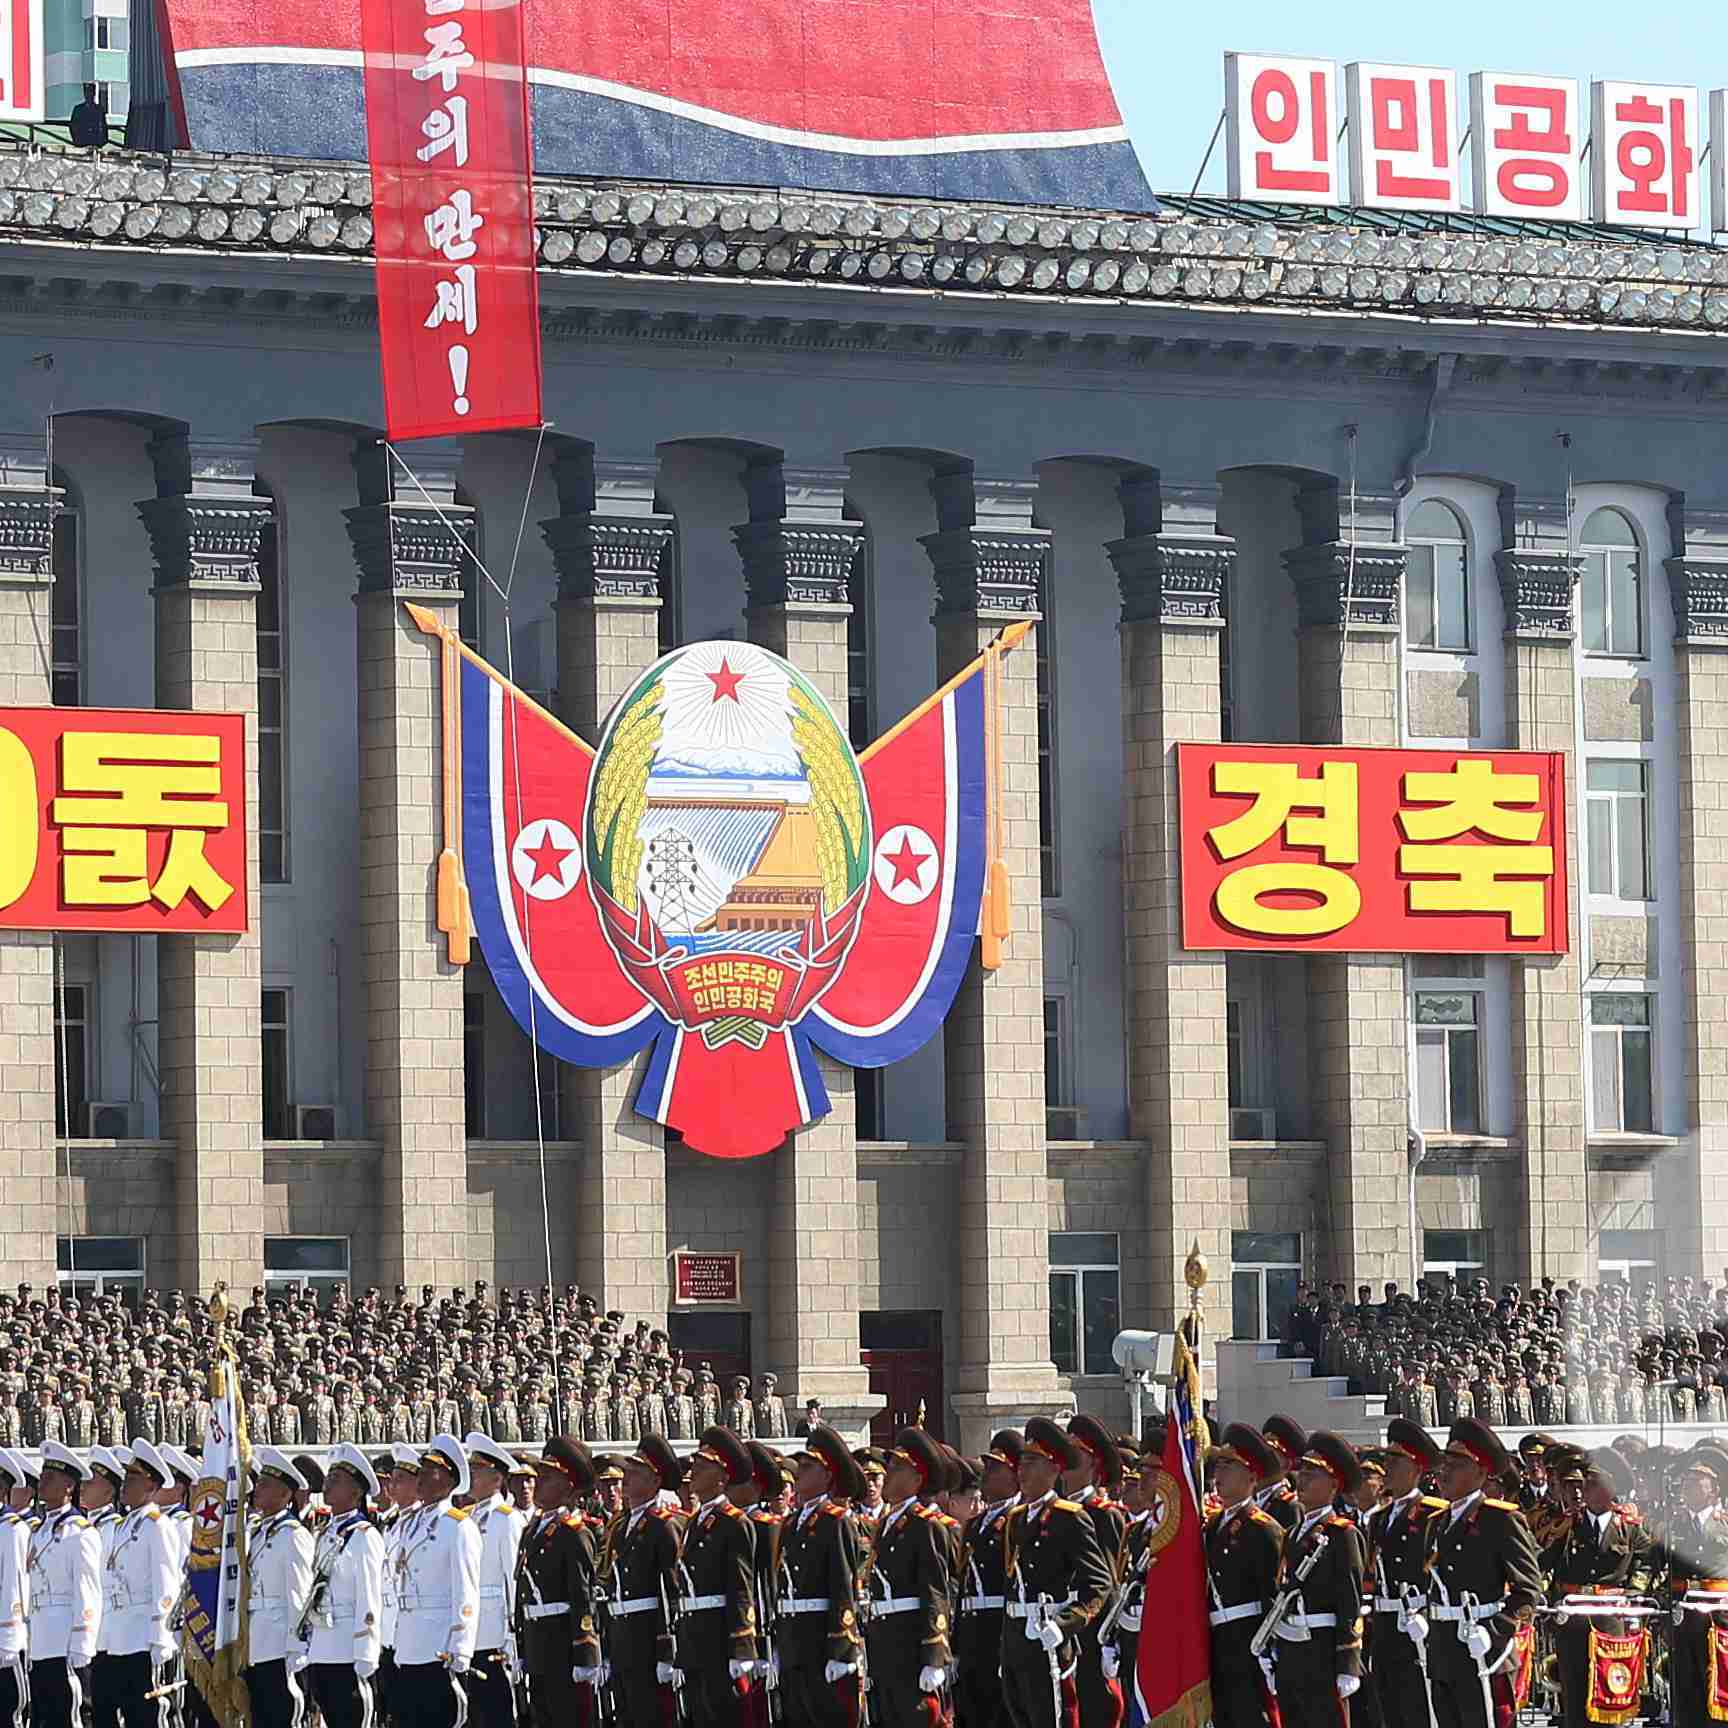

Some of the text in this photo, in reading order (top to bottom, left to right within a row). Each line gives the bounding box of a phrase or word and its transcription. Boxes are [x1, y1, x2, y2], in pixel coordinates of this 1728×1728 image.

[423, 187, 484, 417] 만세!
[1207, 759, 1554, 937] 경축
[683, 961, 784, 992] 조선민주주의
[693, 985, 776, 1014] 인민공화국
